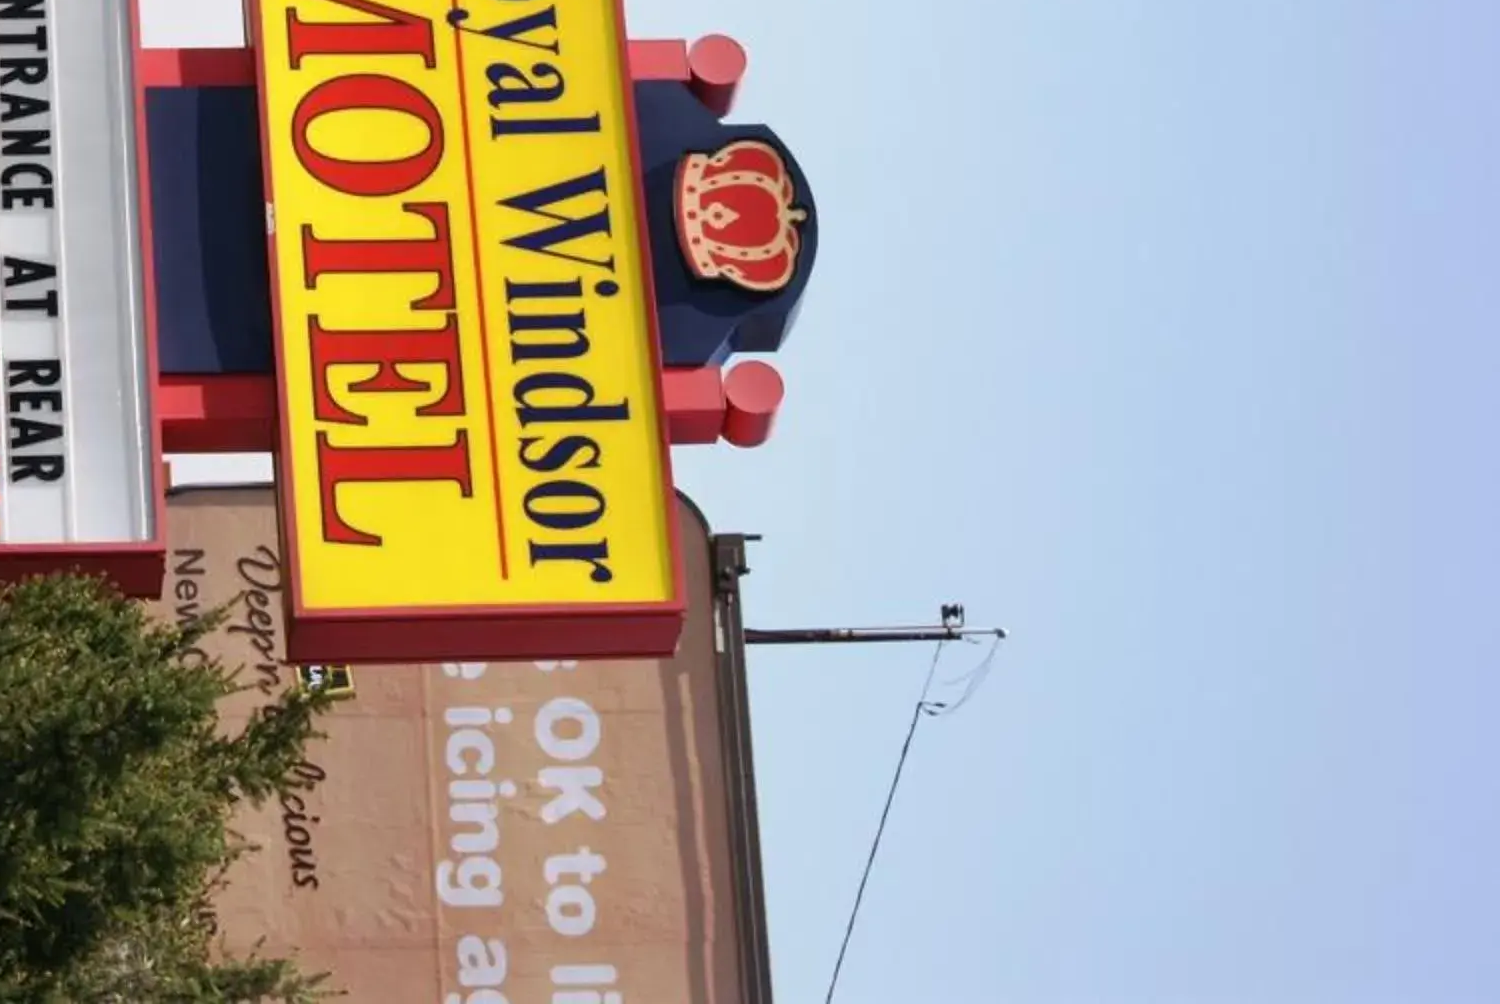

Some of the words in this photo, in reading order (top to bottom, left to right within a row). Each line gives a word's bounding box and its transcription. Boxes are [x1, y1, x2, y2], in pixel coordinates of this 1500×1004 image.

[4, 256, 58, 318] AT
[8, 357, 65, 484] REAR
[499, 169, 630, 583] Windsor
[435, 707, 517, 907] icing
[534, 698, 606, 824] OK
[543, 846, 607, 936] to
